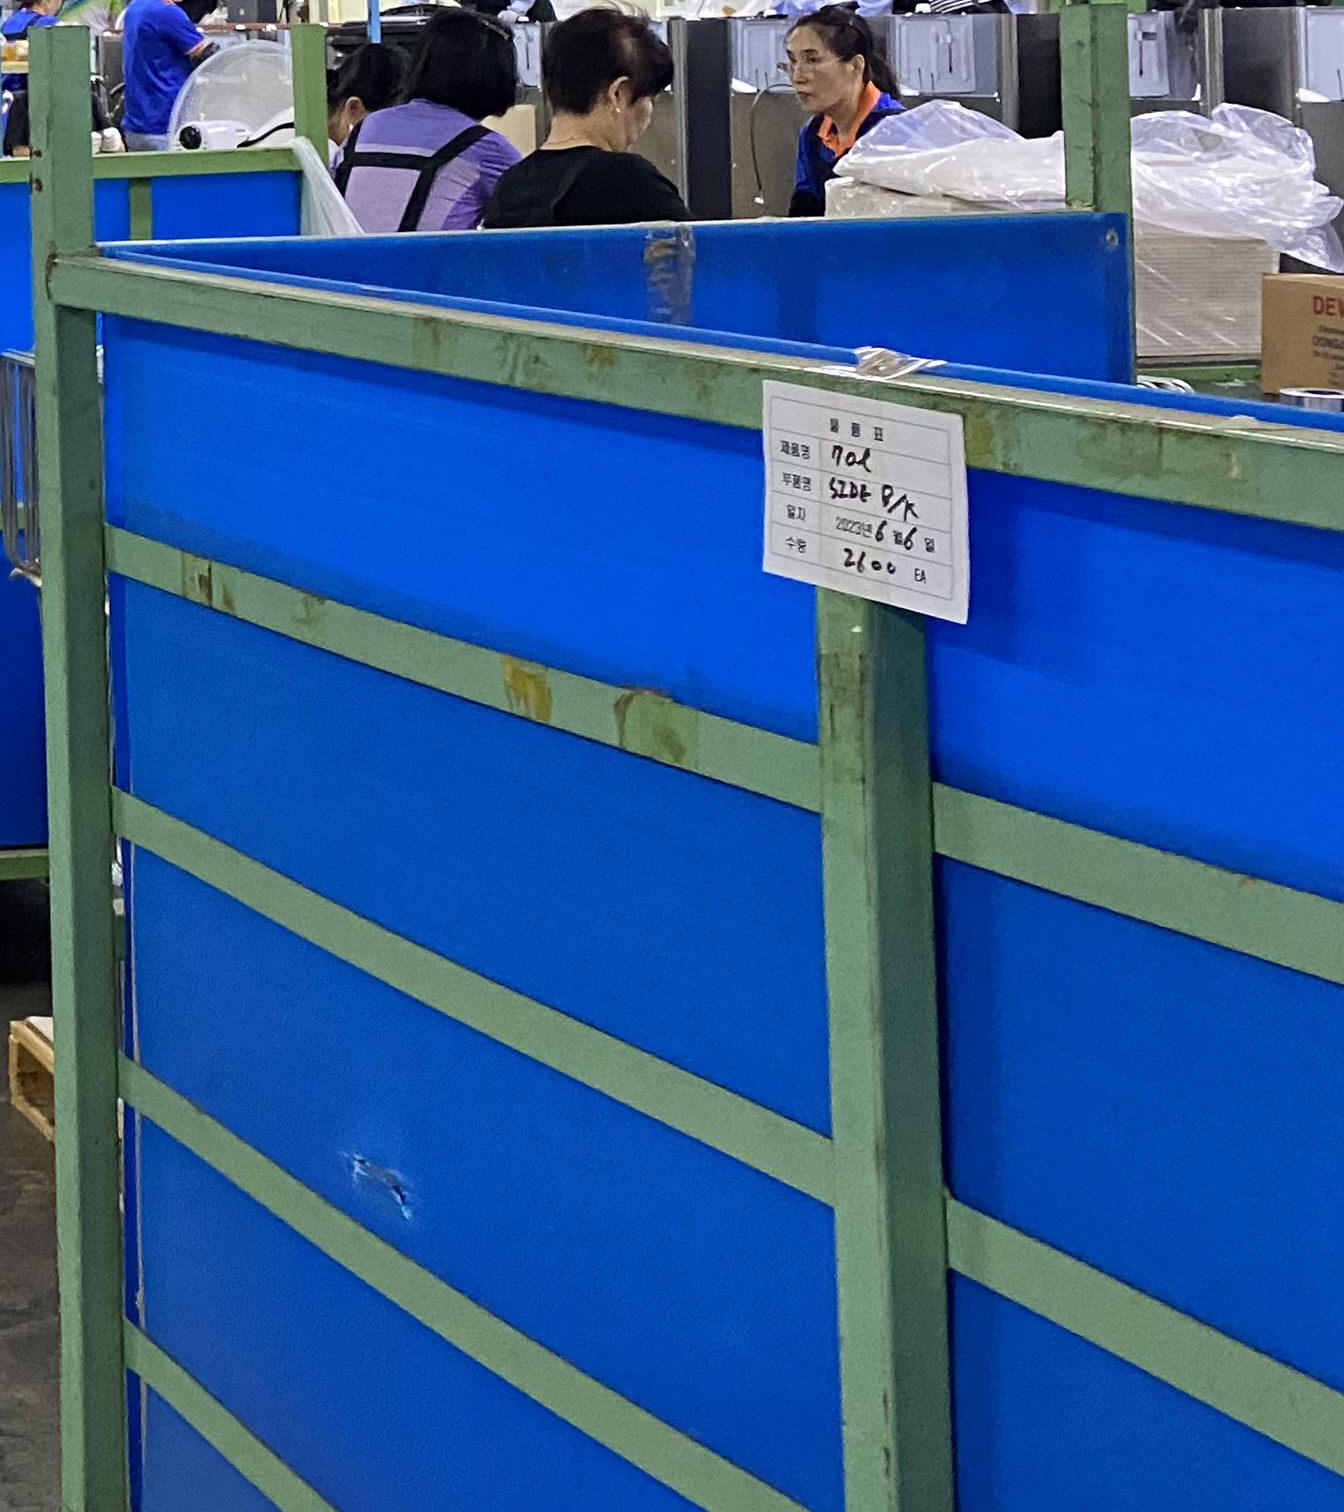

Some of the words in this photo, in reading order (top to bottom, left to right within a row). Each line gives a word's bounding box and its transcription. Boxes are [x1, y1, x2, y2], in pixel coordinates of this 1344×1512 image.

[780, 439, 810, 460] 제품명
[829, 476, 872, 503] SIDE
[913, 567, 927, 585] EA
